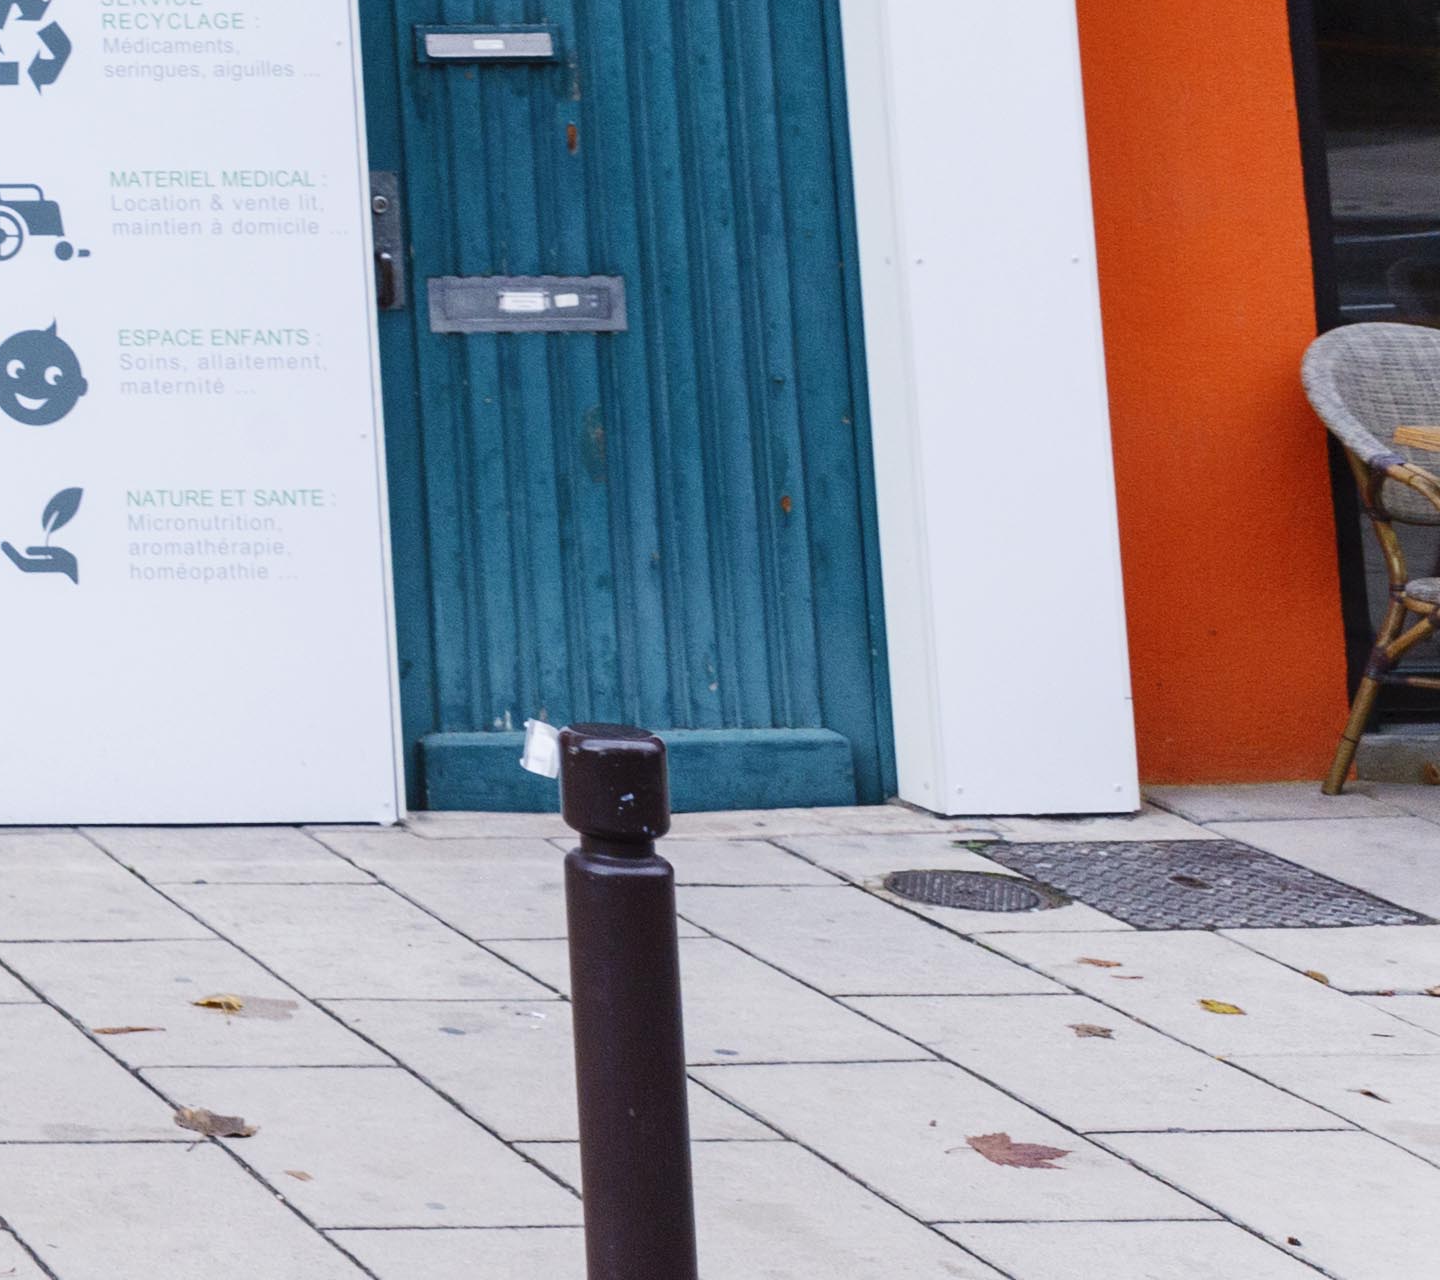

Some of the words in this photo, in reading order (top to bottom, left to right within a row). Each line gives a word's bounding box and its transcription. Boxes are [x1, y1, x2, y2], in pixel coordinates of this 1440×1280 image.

[101, 11, 245, 31] RECYCLAGE
[109, 169, 217, 188] MATERIEL
[221, 169, 317, 188] MEDICAL
[117, 328, 204, 347] ESPACE
[210, 328, 310, 347] ENFANTS
[126, 488, 214, 508] NATURE
[219, 488, 247, 508] ET
[253, 488, 325, 508] SANTE
